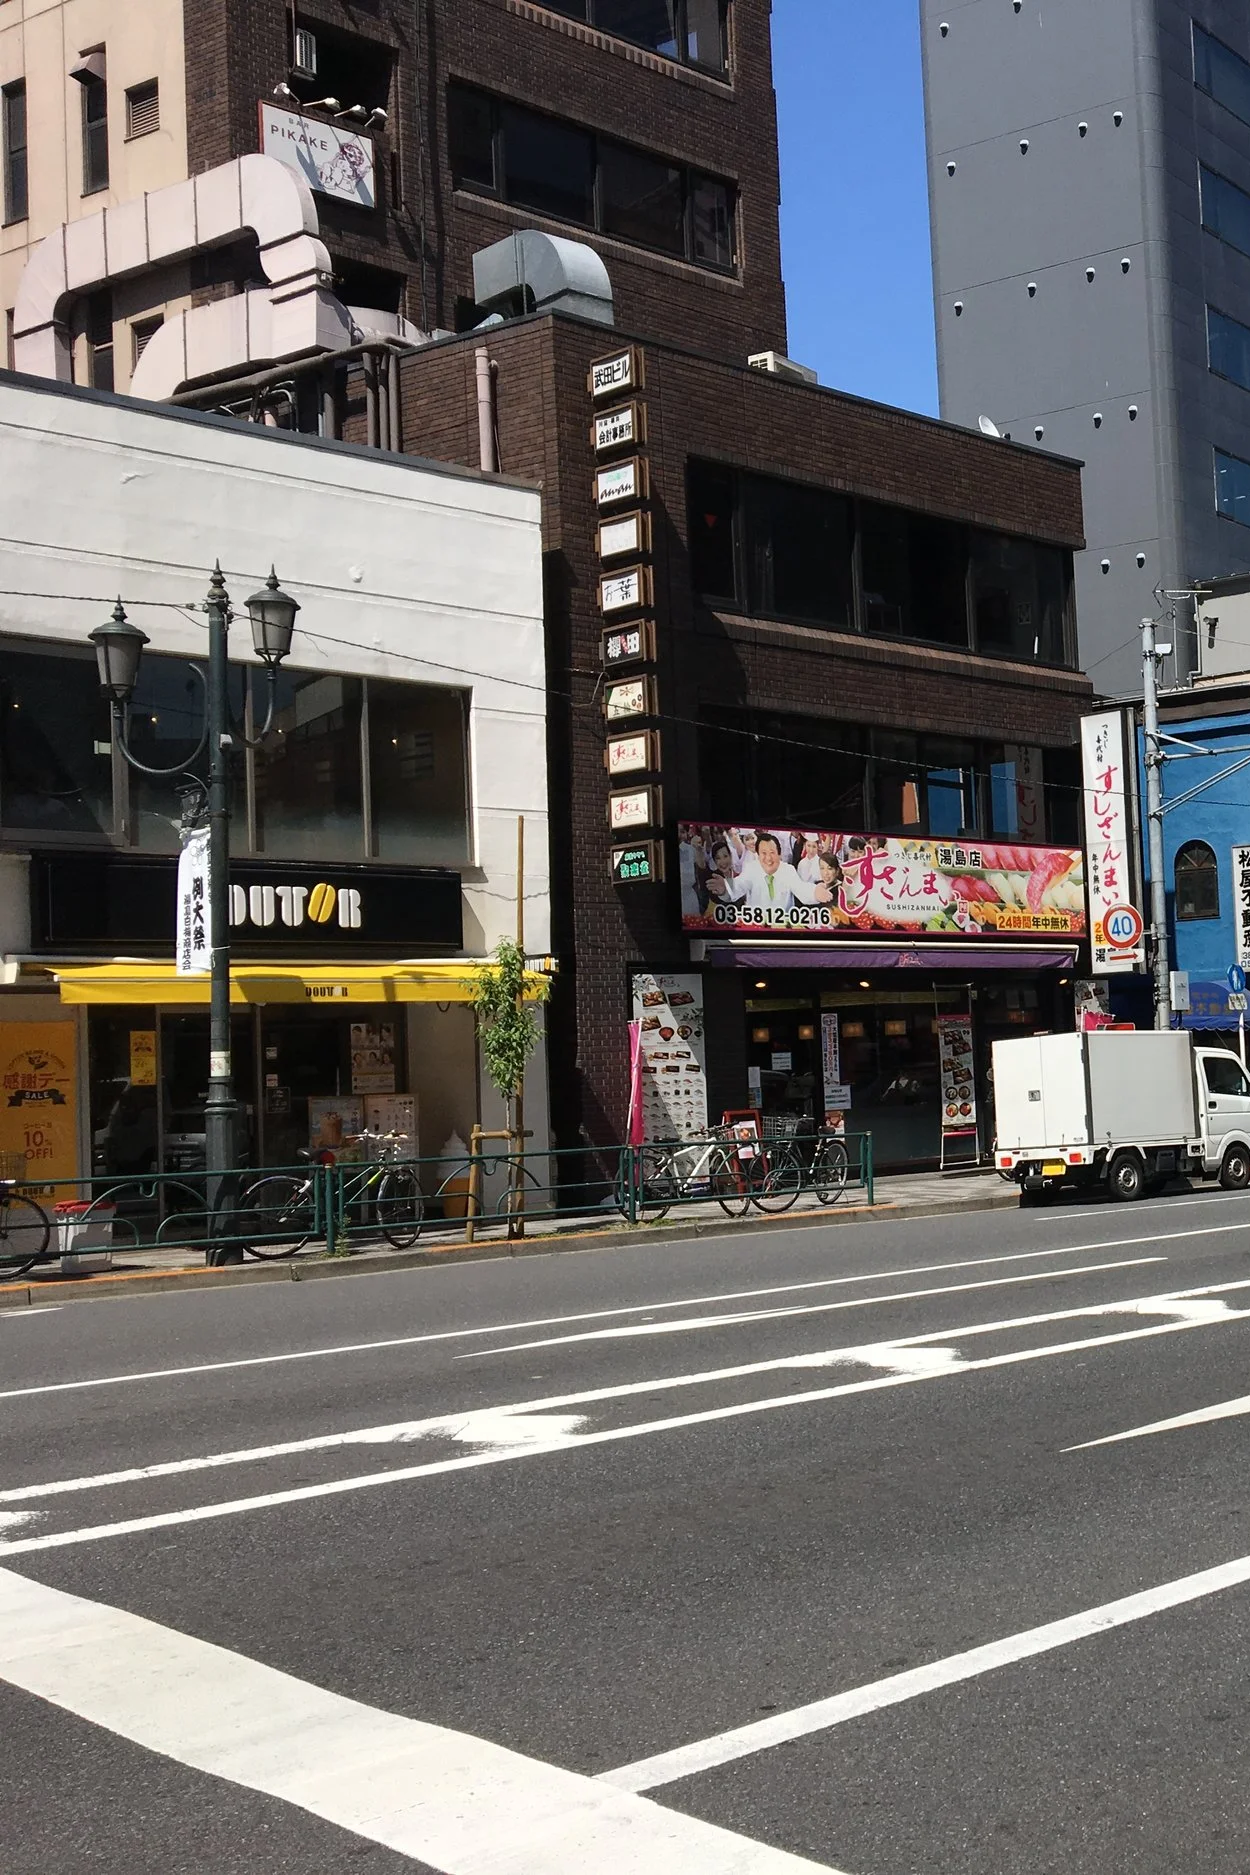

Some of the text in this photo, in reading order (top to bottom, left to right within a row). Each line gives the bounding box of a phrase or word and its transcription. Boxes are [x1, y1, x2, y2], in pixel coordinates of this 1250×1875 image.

[288, 117, 310, 130] BAR
[270, 124, 329, 152] PIKAKE
[594, 360, 630, 389] 武田ビル
[599, 421, 632, 445] 会計事務所
[939, 847, 982, 867] 湯島店
[192, 876, 205, 951] 例大祭
[228, 882, 362, 928] OUTOR
[715, 905, 831, 924] 03-5812-0216
[886, 903, 940, 912] SUSHIZANMAI
[997, 915, 1070, 930] 24時間年中無休
[1111, 915, 1133, 936] 40
[305, 986, 348, 998] DOUTOR
[3, 1071, 70, 1091] 感謝デー
[24, 1090, 50, 1100] SALE
[24, 1149, 53, 1160] OFF!
